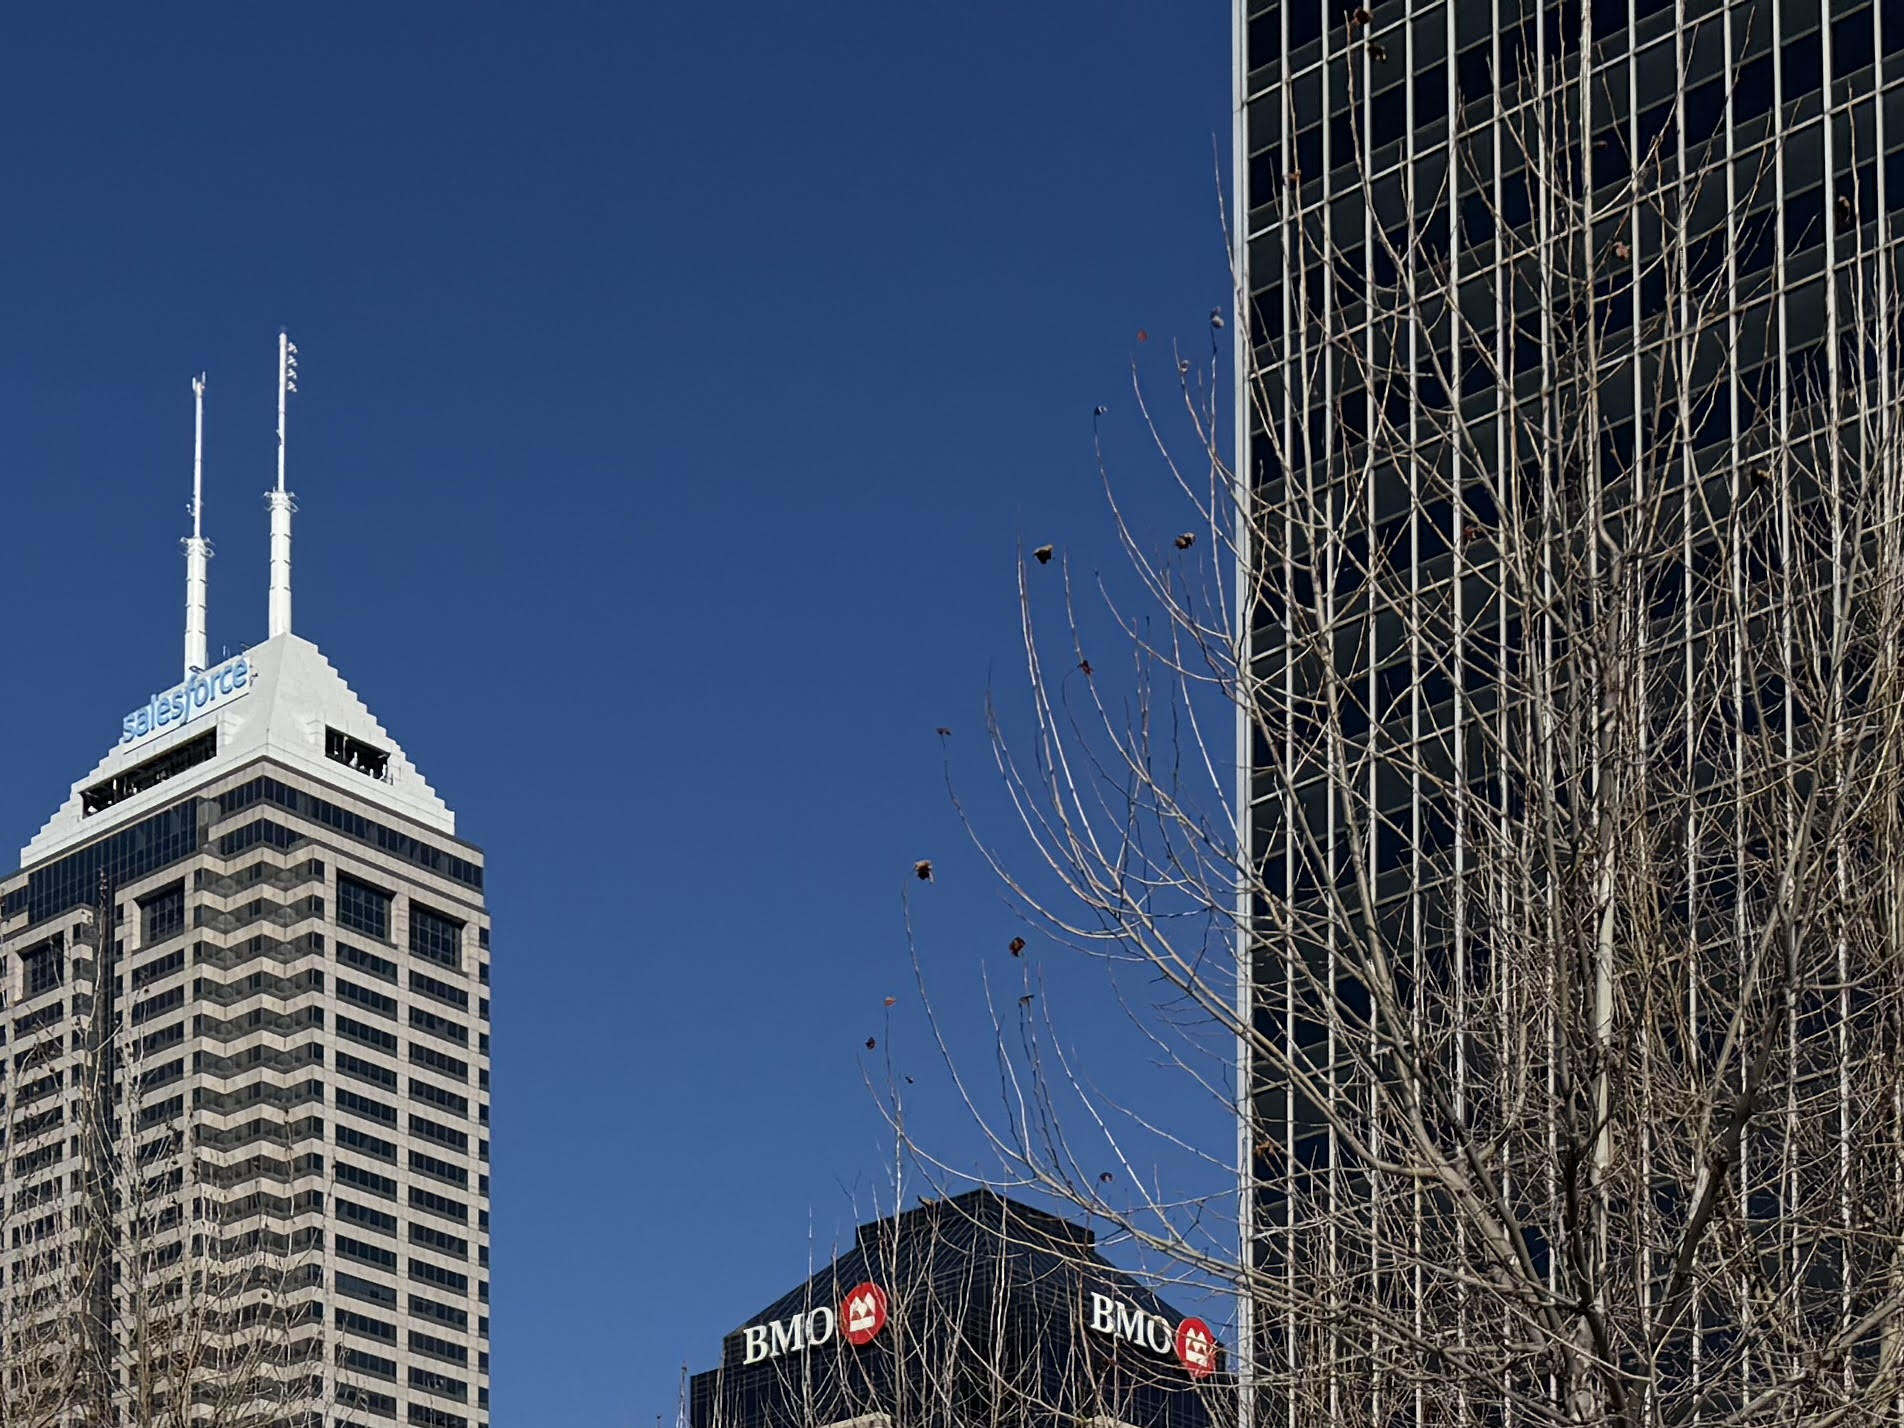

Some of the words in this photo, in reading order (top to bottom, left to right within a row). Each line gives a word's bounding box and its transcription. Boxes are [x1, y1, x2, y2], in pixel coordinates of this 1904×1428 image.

[122, 655, 250, 744] salesforce
[742, 1306, 834, 1366] BMO
[1090, 1291, 1172, 1355] BMO
